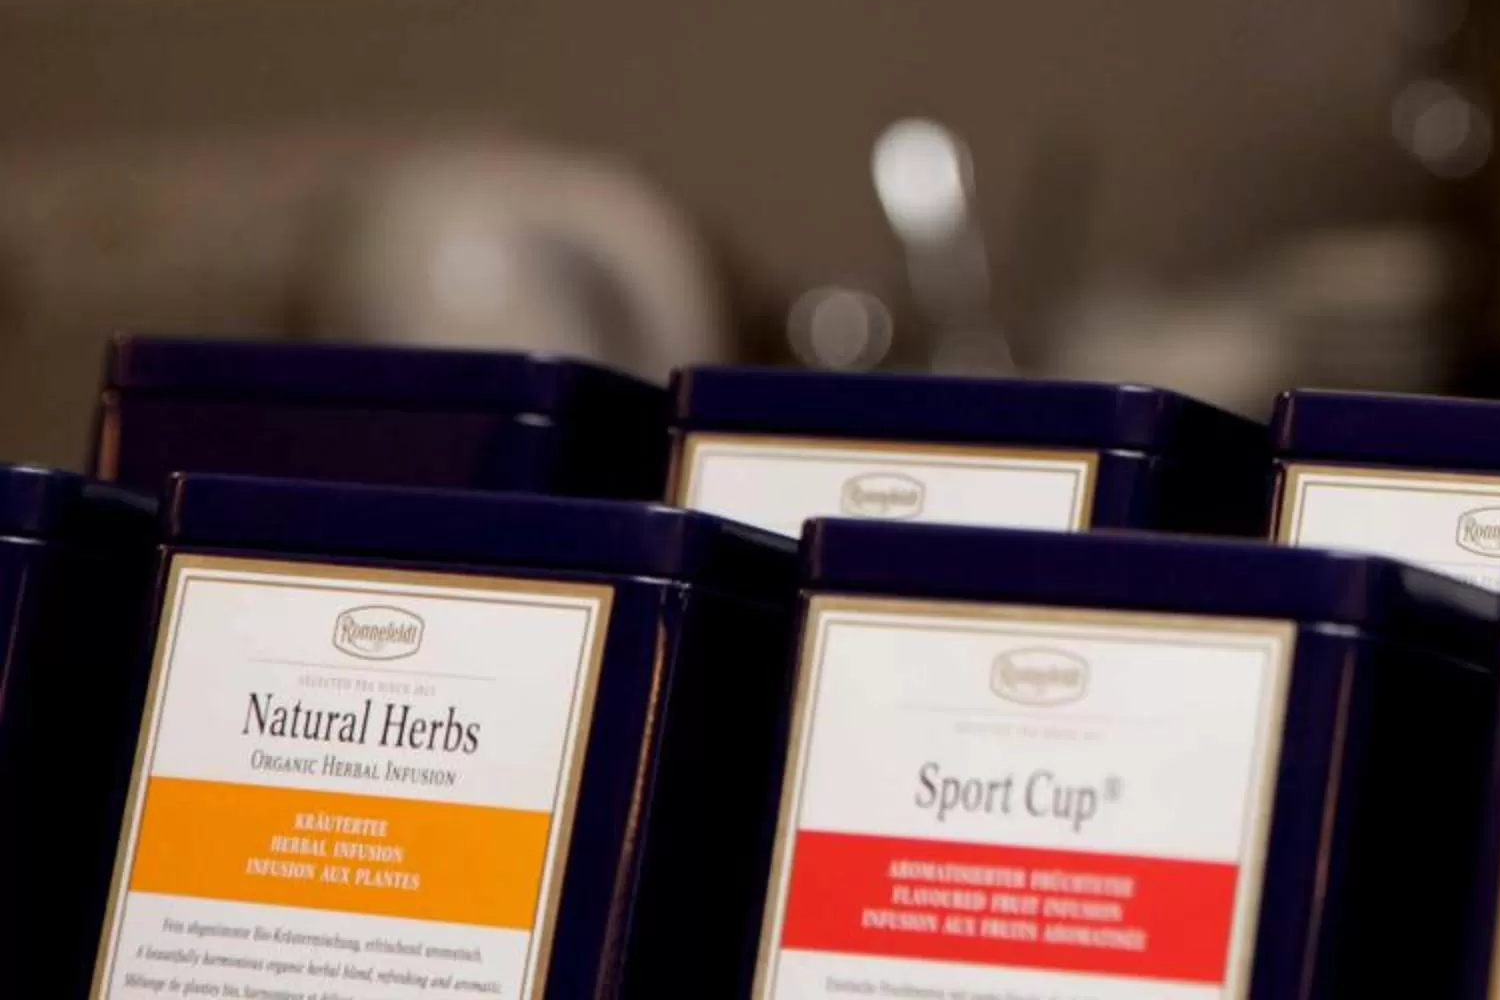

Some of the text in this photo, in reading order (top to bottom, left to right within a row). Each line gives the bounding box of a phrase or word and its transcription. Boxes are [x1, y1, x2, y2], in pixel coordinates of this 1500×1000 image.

[242, 691, 481, 754] Natural Herbs
[914, 761, 1013, 822] Sport
